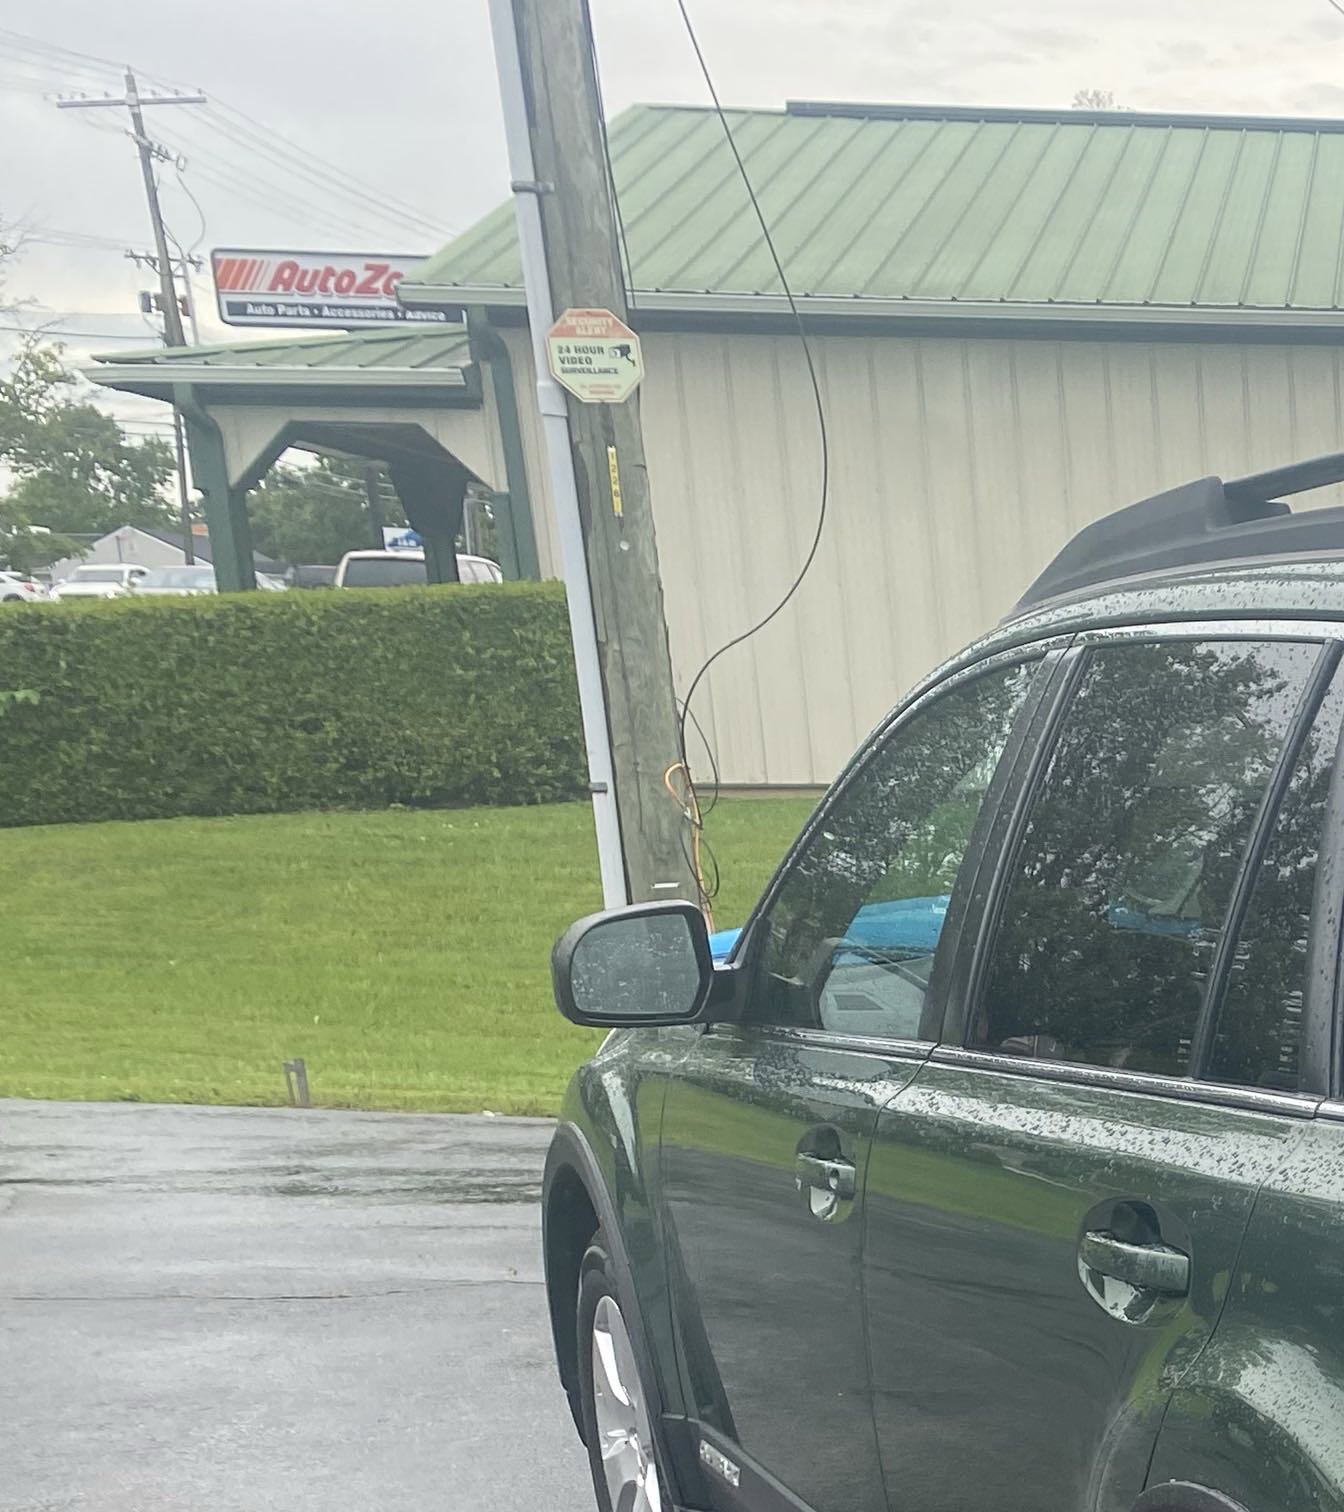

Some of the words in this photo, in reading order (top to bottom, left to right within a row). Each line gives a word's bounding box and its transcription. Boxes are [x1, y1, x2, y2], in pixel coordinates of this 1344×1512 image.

[268, 260, 404, 296] AutoZo
[246, 304, 275, 316] Auto
[278, 304, 311, 317] Parts
[322, 306, 395, 320] Accessories
[557, 345, 571, 354] 24
[574, 345, 605, 355] HOUR
[559, 356, 593, 366] VIDEO
